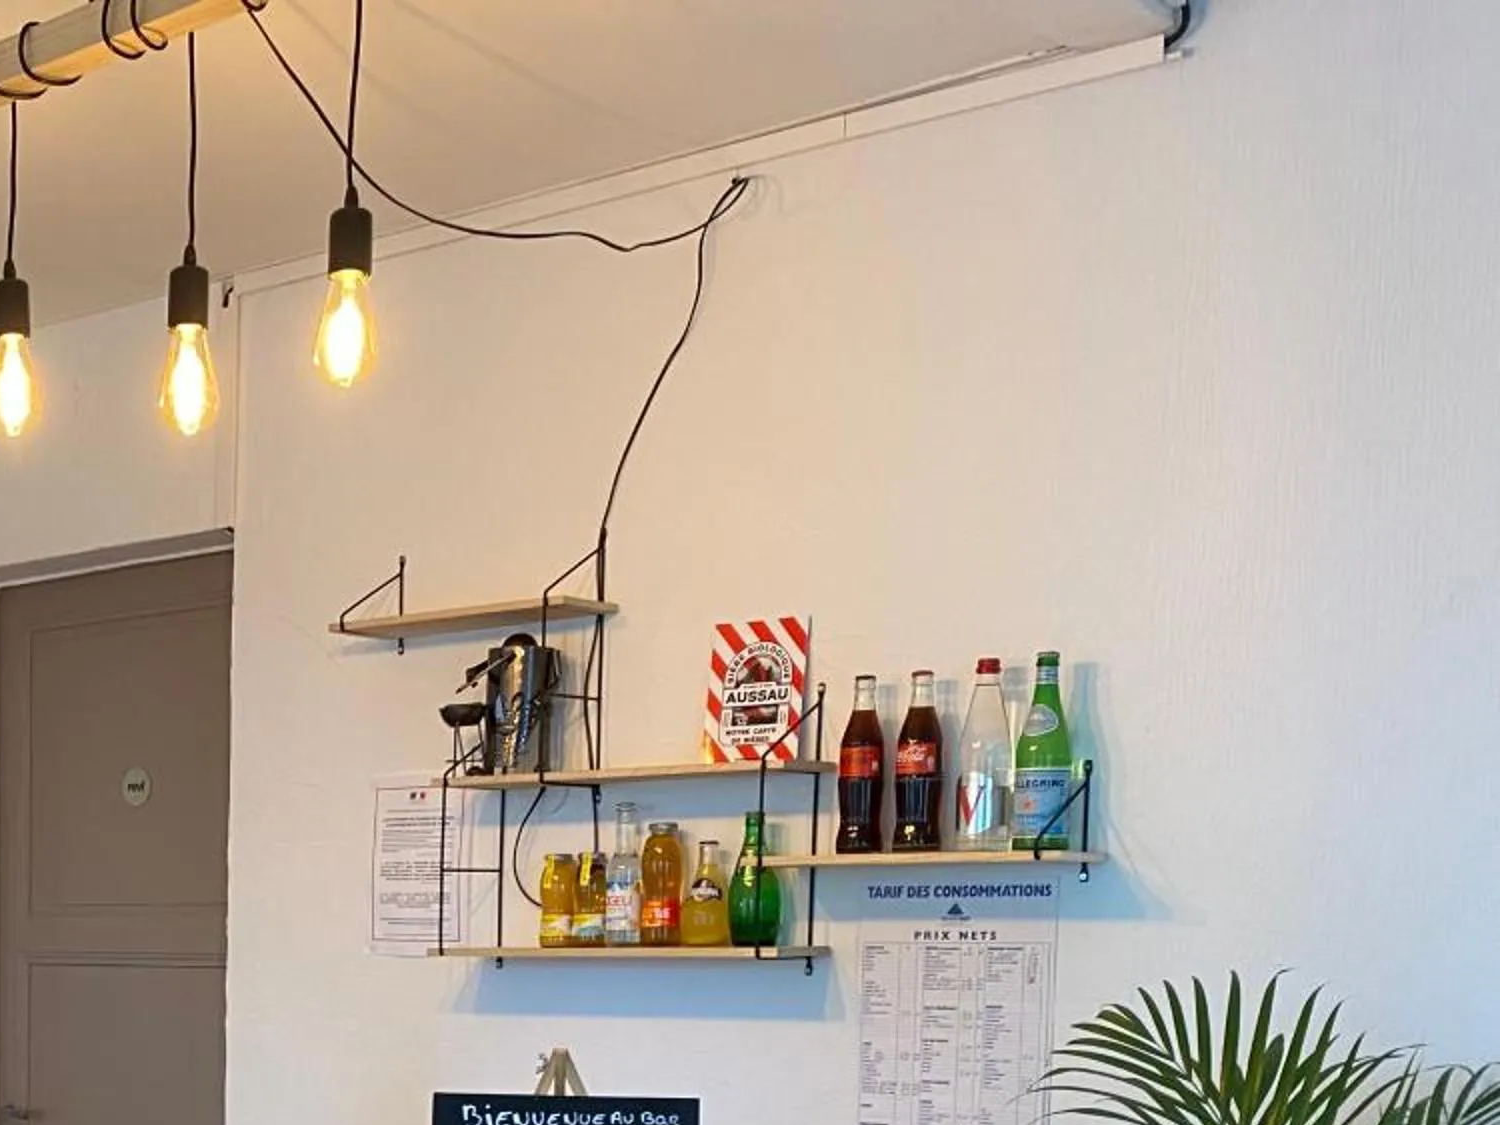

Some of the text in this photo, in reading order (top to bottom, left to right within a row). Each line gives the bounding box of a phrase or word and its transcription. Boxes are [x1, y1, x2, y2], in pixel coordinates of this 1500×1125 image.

[725, 687, 789, 704] AUSSAU
[868, 884, 1052, 899] TARIF DES CONSOMMATIONS
[914, 931, 997, 941] PRIX NETS
[610, 1111, 635, 1125] AU
